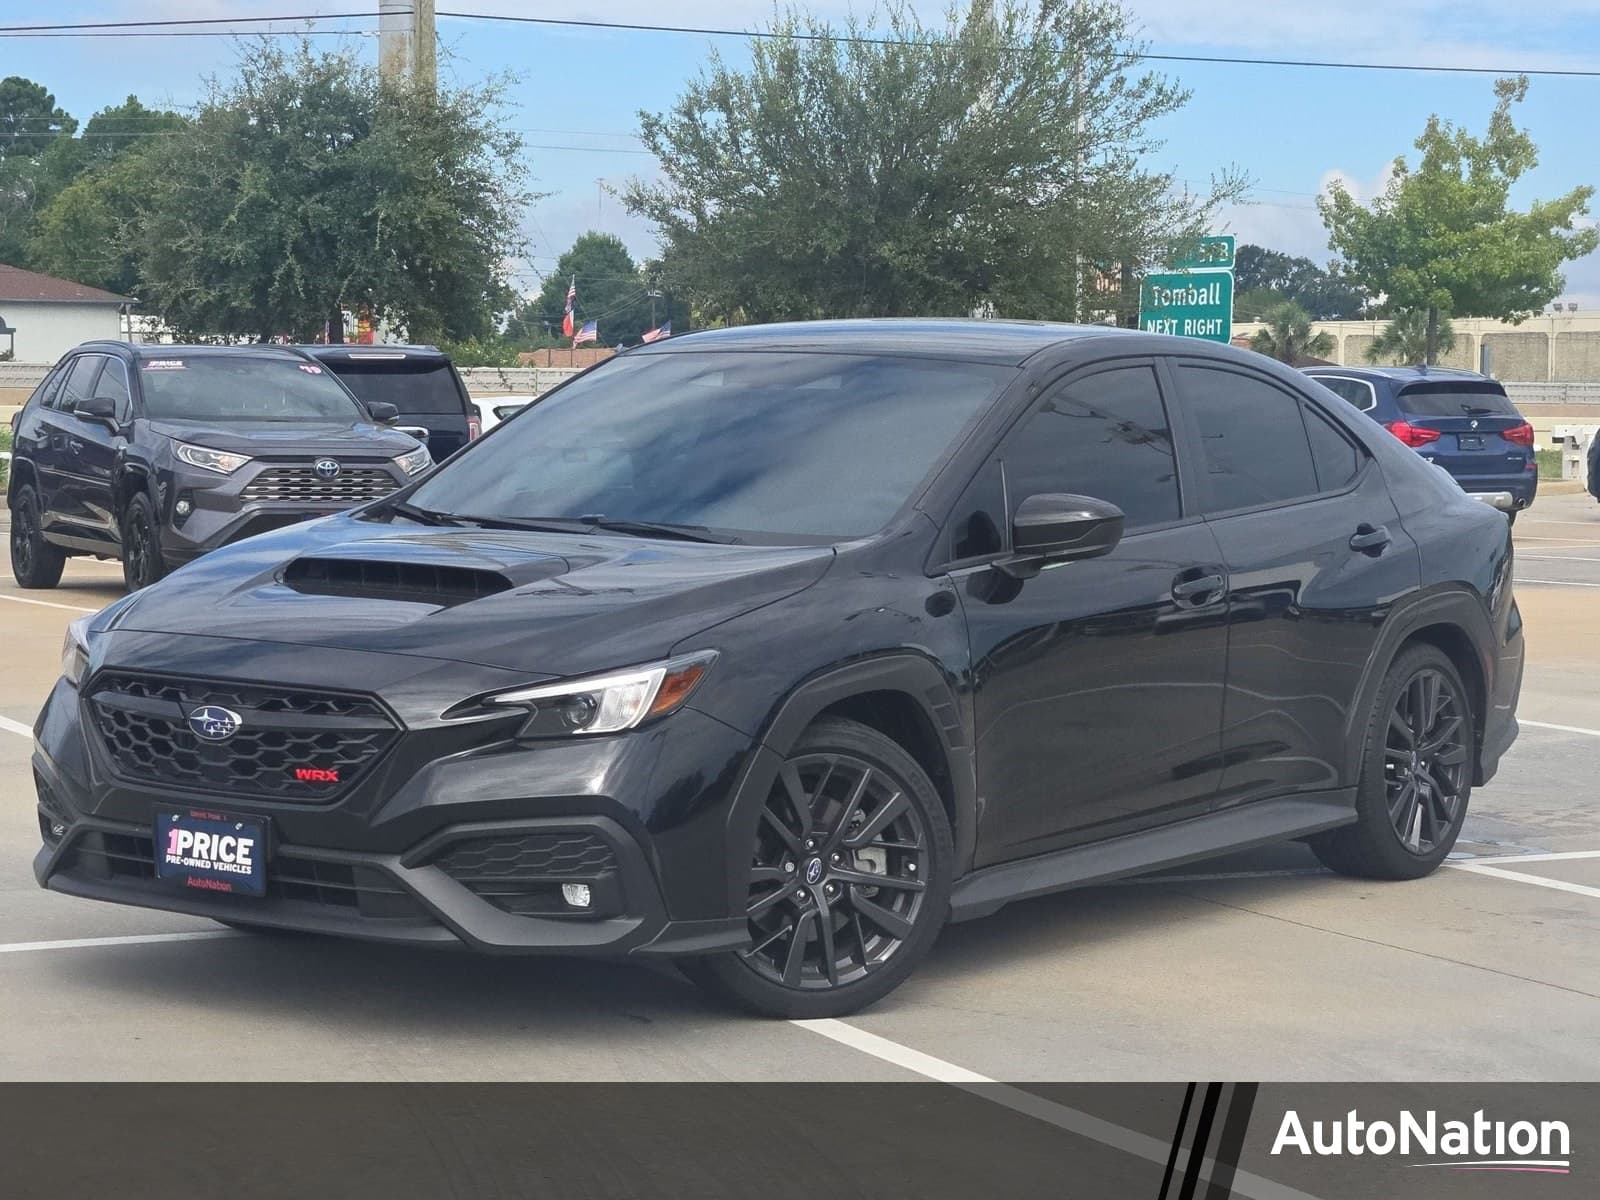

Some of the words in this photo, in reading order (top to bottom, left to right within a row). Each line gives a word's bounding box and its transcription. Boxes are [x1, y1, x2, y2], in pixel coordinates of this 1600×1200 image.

[1152, 283, 1220, 306] Tomball
[1147, 319, 1178, 335] NEXT
[1184, 319, 1222, 335] RIGHT
[295, 768, 339, 782] WRX
[167, 828, 254, 866] 1PRICE
[165, 854, 211, 869] PRE-OWNED
[213, 861, 252, 875] VEHICLES
[187, 876, 232, 892] AutoNation
